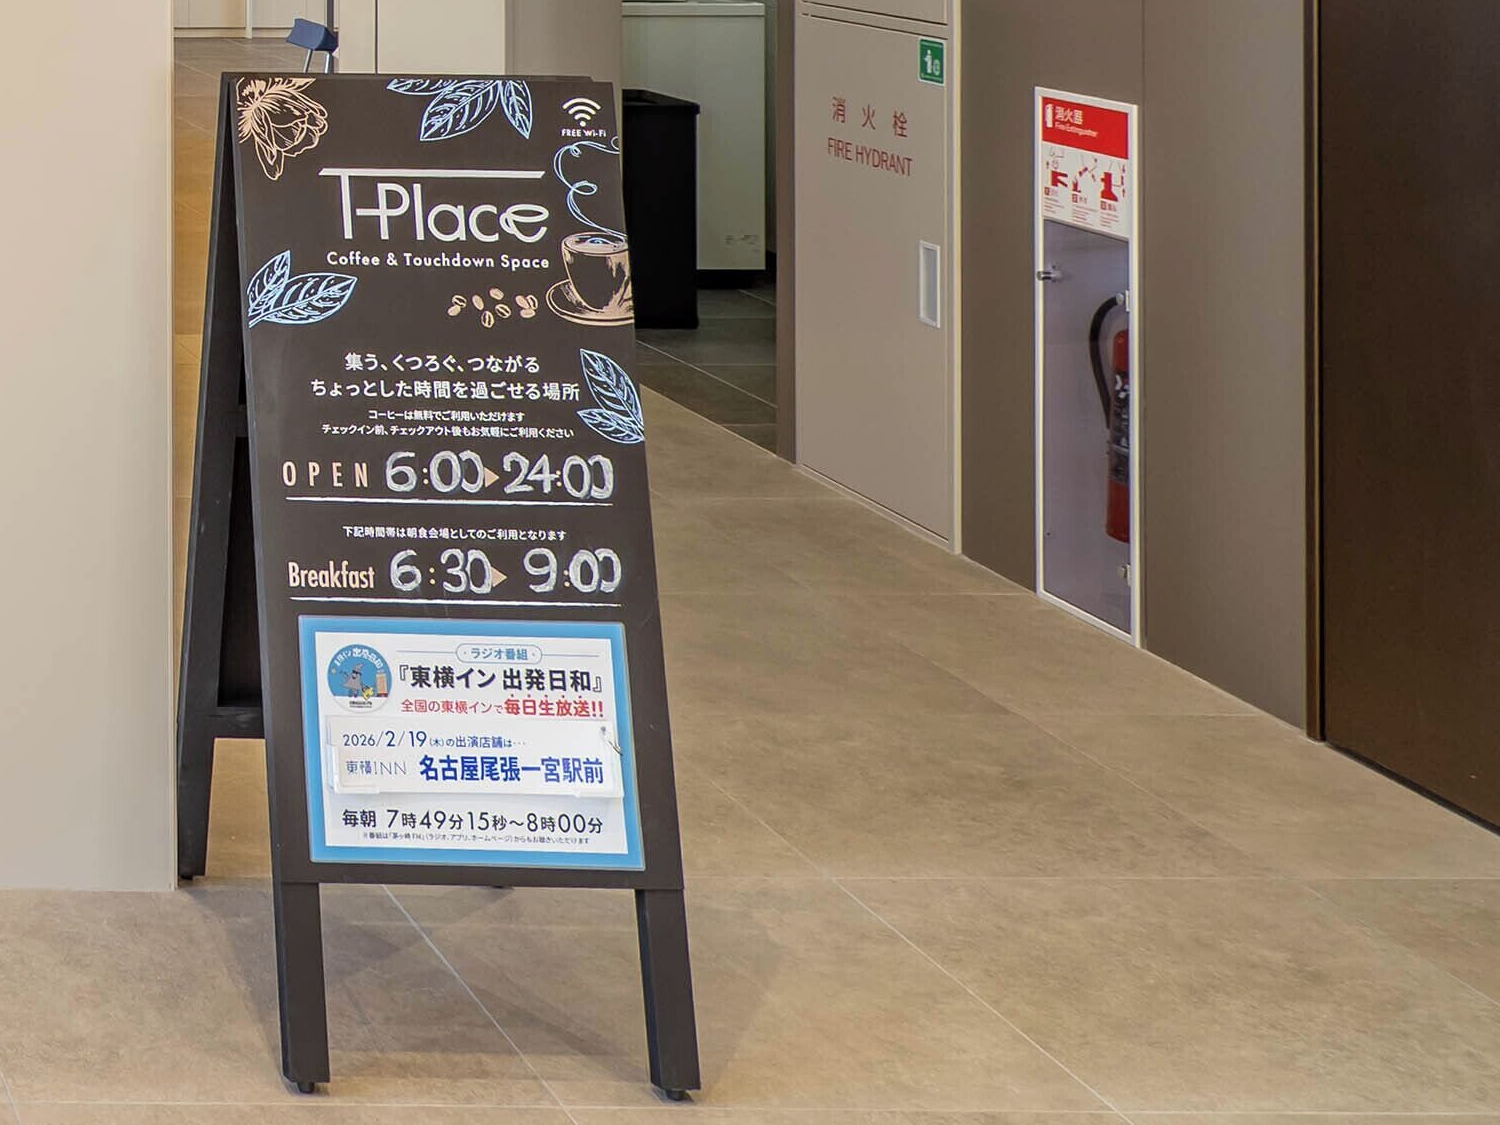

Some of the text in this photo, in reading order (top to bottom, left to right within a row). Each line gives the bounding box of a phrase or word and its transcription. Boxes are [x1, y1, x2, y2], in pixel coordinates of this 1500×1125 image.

[832, 96, 909, 139] 消火栓
[561, 128, 607, 138] FREE Wi-Fi
[827, 137, 913, 178] FIRE HYDRANT
[327, 251, 550, 271] Coffee & Touchdown Space
[344, 352, 540, 374] 集う、くつろぐ、つながる
[311, 378, 580, 402] ちょっとした時間を過ごせる場所
[368, 409, 525, 423] コーヒーは無料でご利用いただけます
[321, 424, 574, 439] チェックイン前、チェックアウト後もお気軽にご利用ください
[282, 461, 369, 488] OPEN
[342, 526, 567, 542] 下記時間帯は朝食会場としてのご利用となります
[287, 561, 376, 589] Breakfast
[389, 547, 492, 594] 6:30
[470, 647, 529, 662] ラジオ番組
[419, 754, 605, 784] 名古屋尾張一宮駅前
[342, 809, 378, 828] 毎朝
